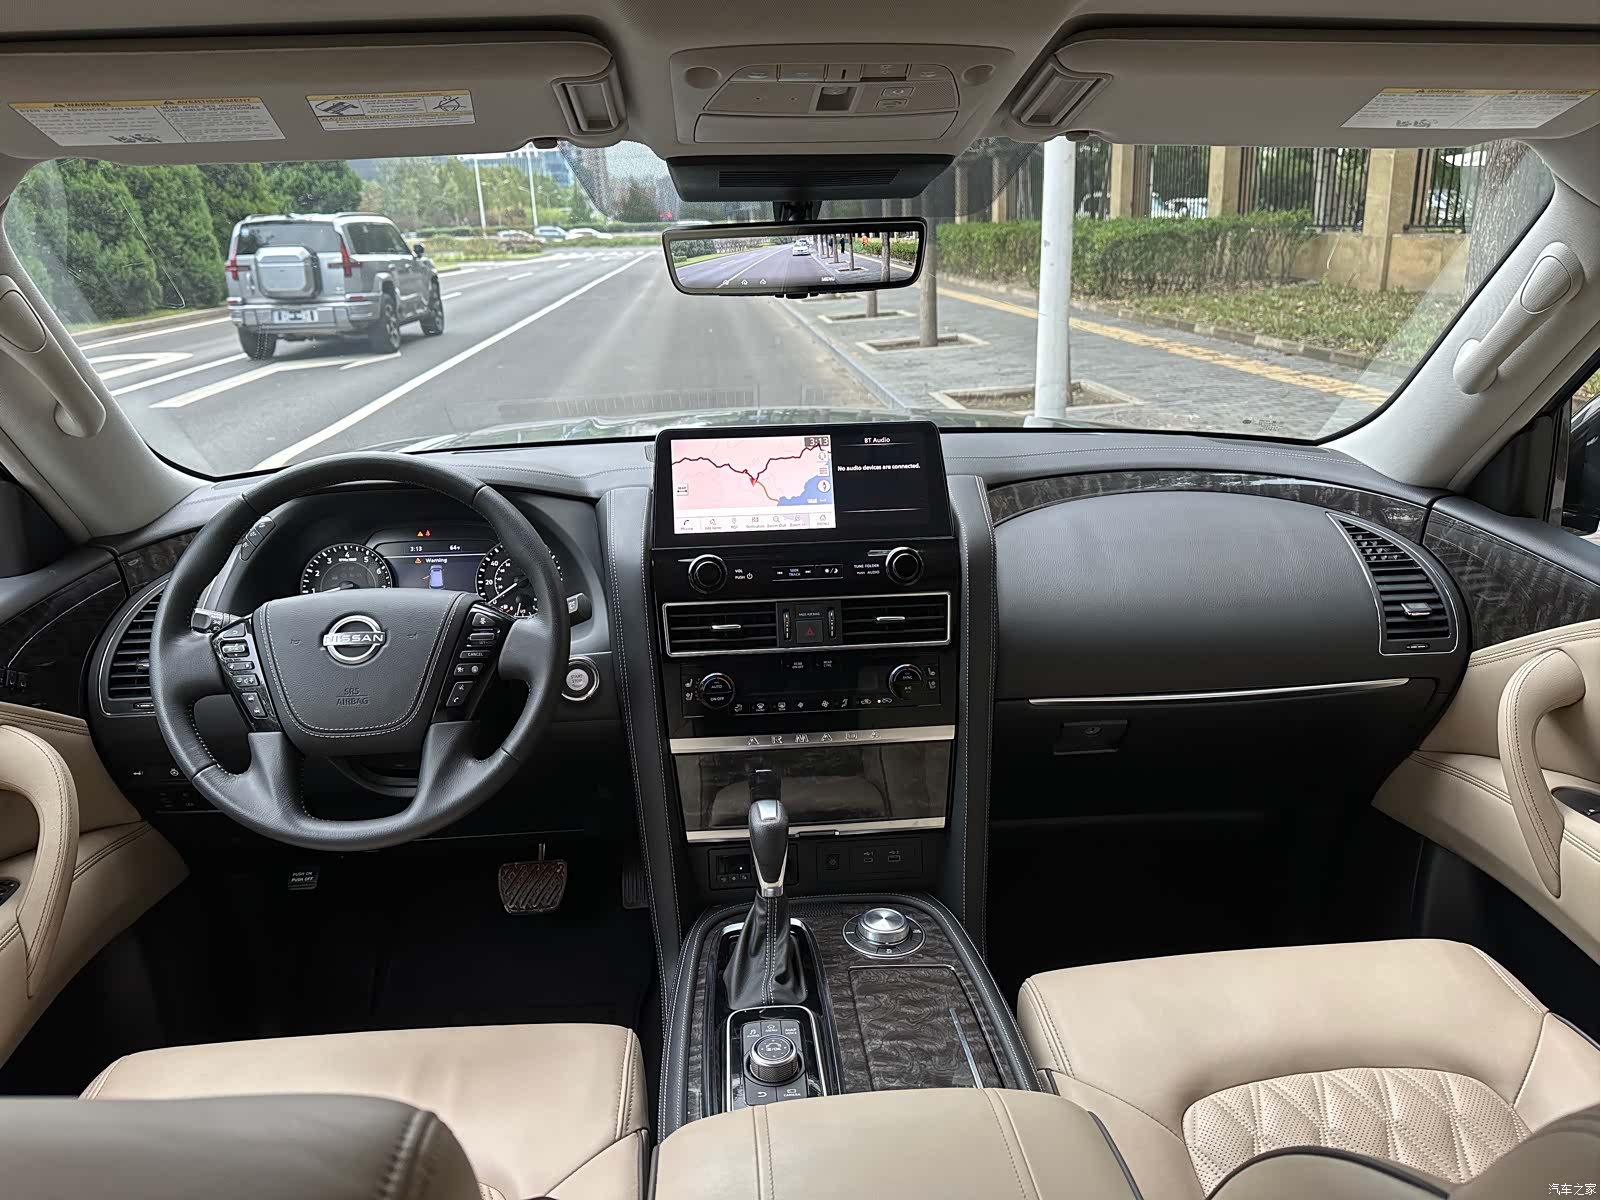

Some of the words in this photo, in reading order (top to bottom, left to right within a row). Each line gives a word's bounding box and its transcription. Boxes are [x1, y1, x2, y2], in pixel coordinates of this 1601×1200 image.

[809, 437, 829, 446] 3:13
[327, 557, 332, 565] 3
[324, 634, 384, 643] NISSAN
[344, 687, 361, 695] SRS
[336, 697, 369, 706] AIRBAG
